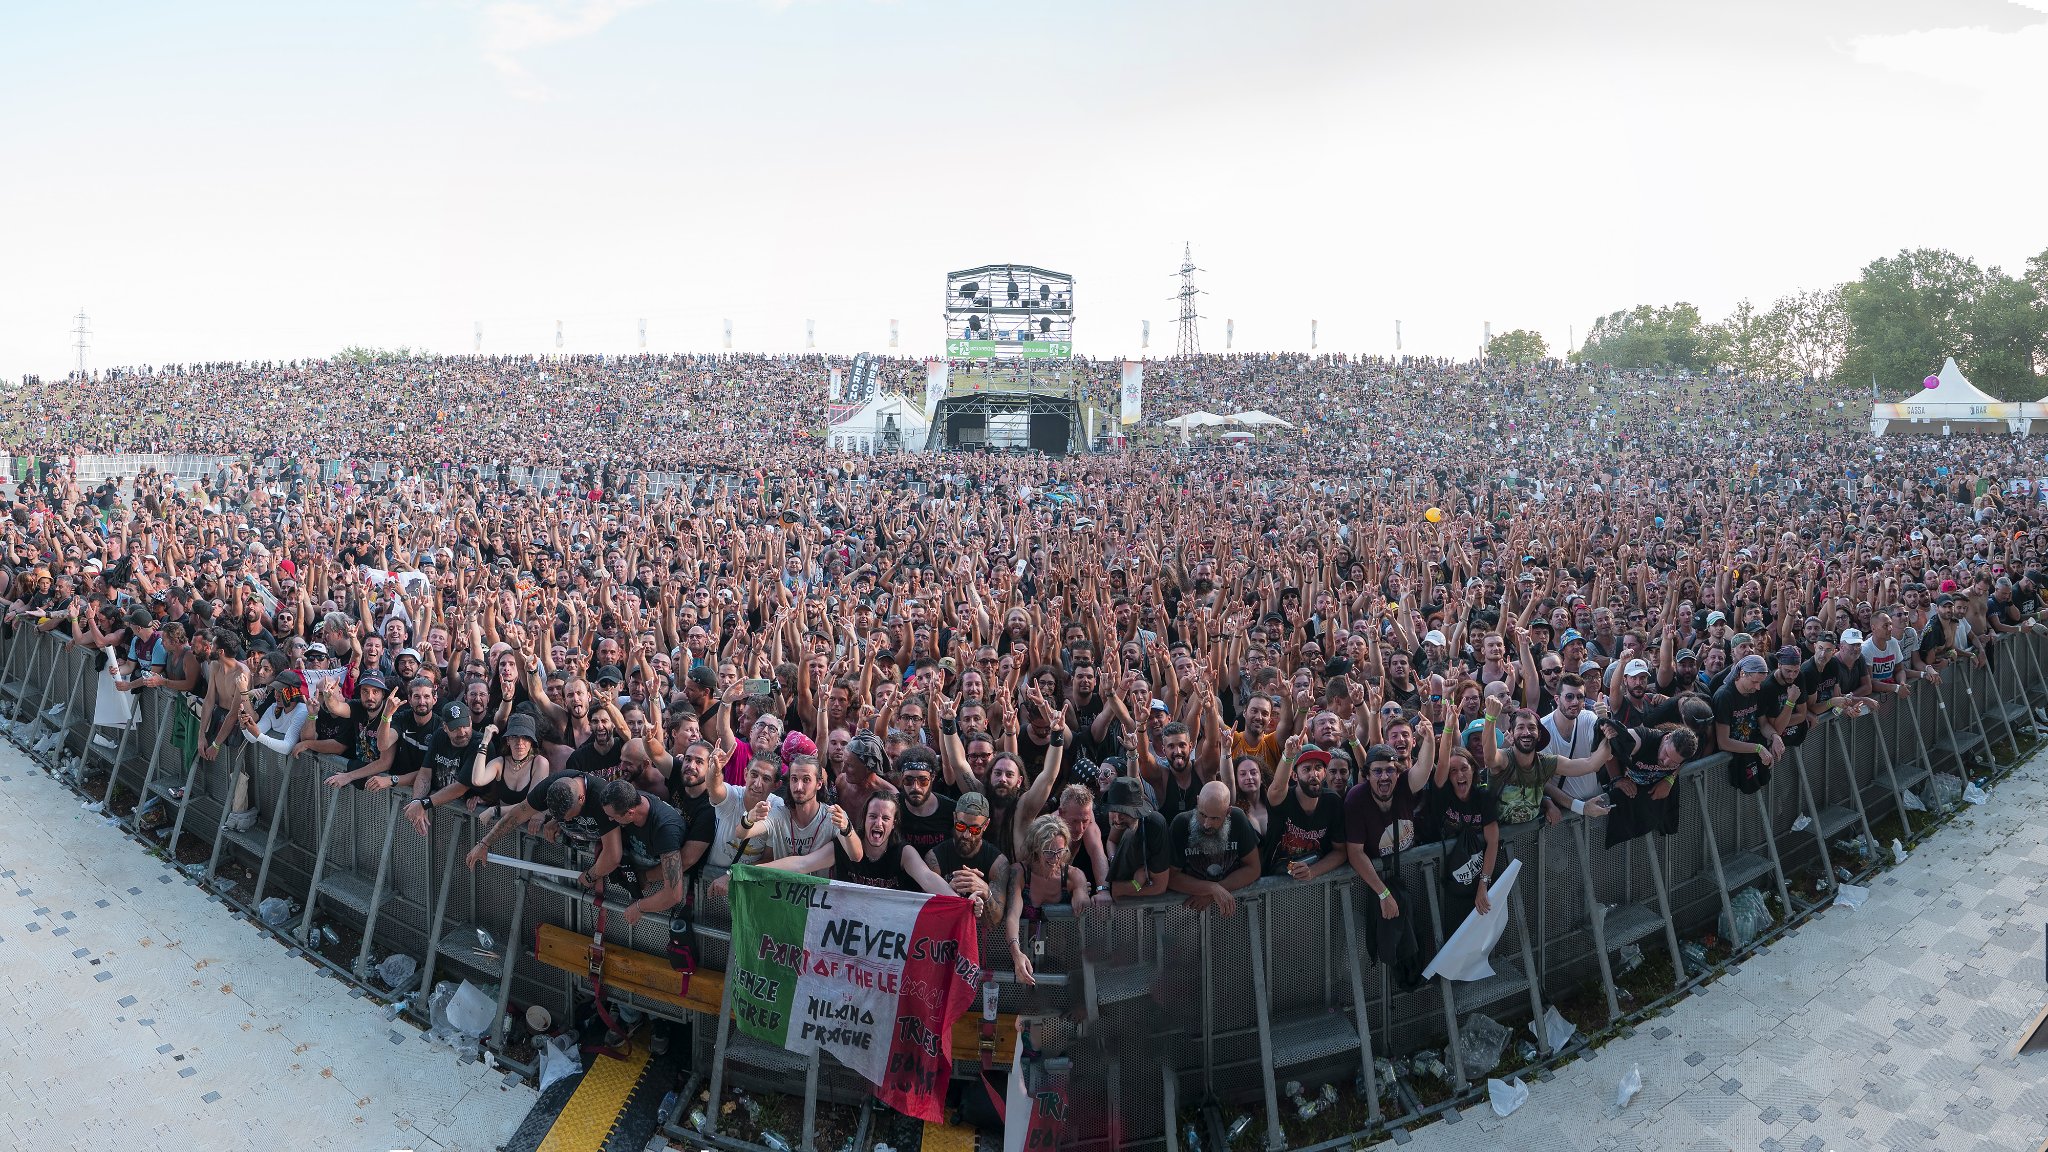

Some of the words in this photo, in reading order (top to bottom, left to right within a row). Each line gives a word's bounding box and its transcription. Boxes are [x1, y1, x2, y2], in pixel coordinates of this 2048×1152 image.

[849, 357, 866, 399] MERCH
[865, 361, 879, 400] MERCH
[1907, 406, 1925, 414] CASSA
[1872, 661, 1895, 673] NASA
[770, 881, 832, 909] SHALL
[820, 918, 907, 961] NEVER
[758, 933, 811, 977] PART
[813, 958, 838, 977] OF
[844, 963, 874, 989] THE
[737, 967, 780, 1003] ENZE
[807, 995, 875, 1026] MILANO
[800, 1021, 873, 1050] PRAGUE
[898, 1015, 942, 1058] TRIES
